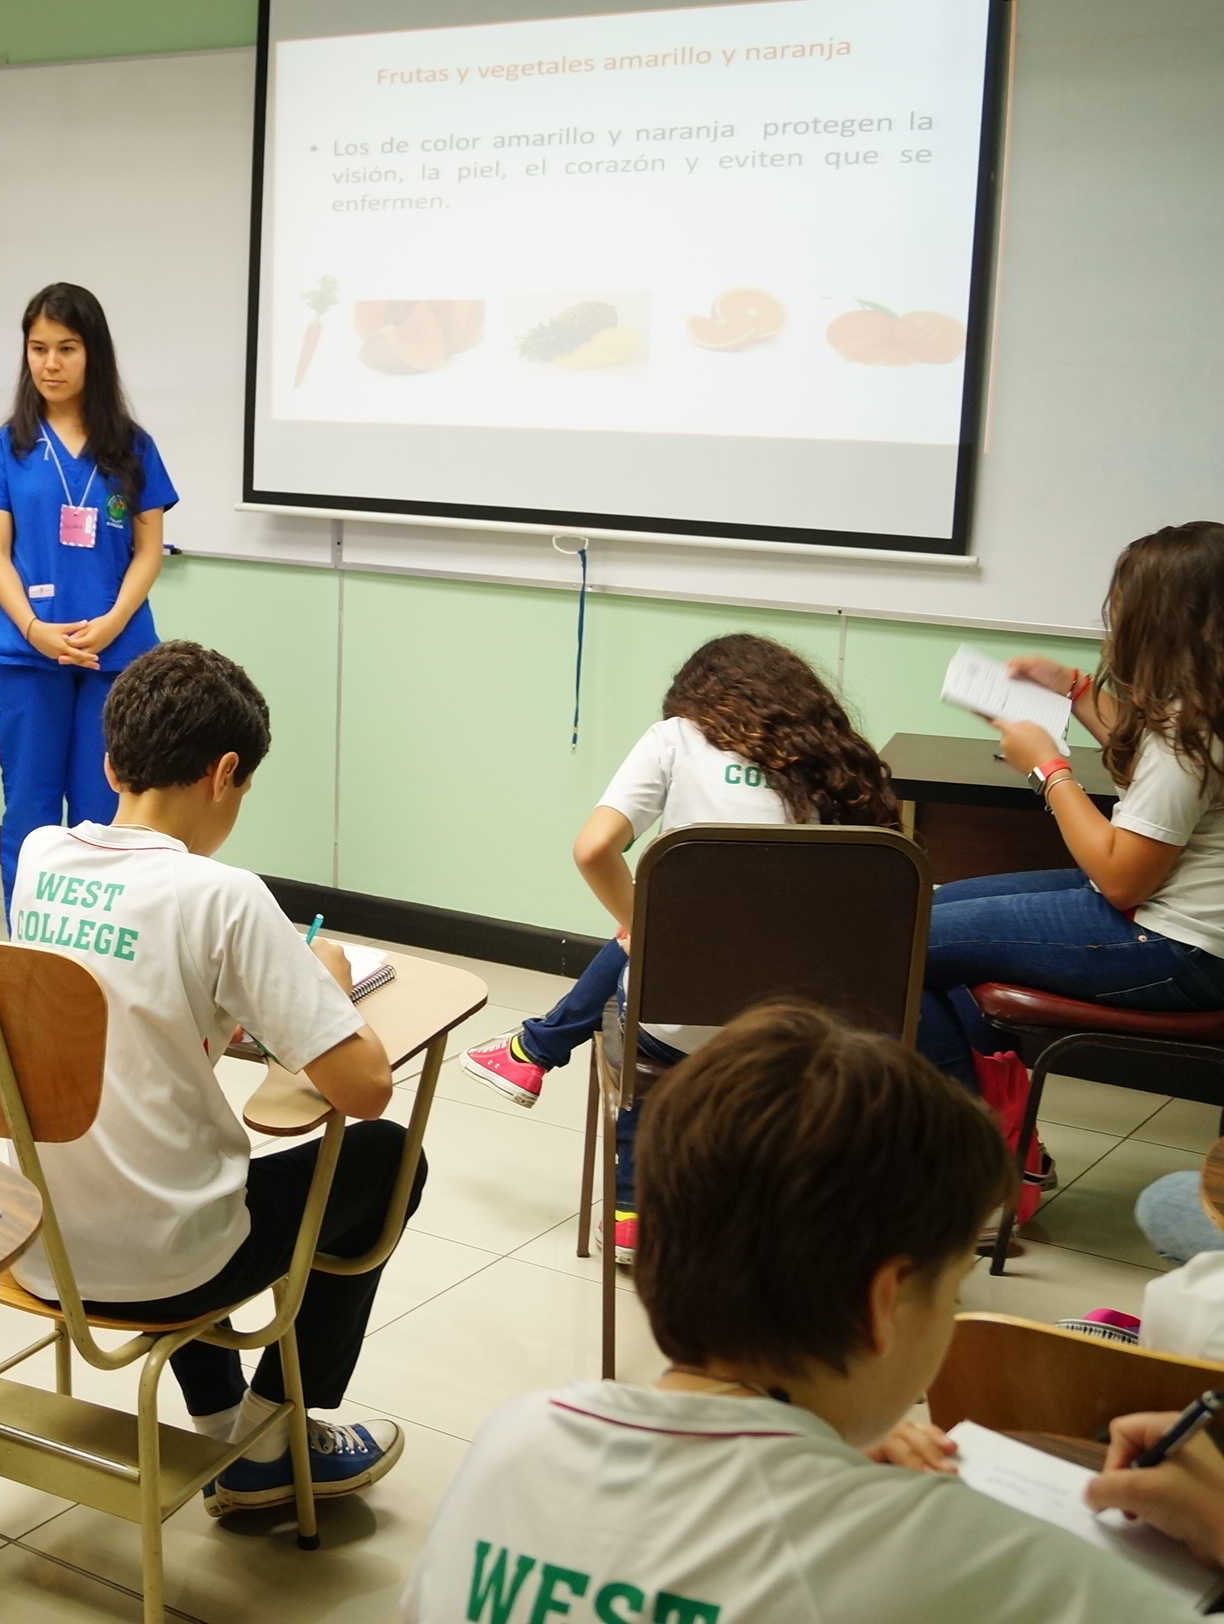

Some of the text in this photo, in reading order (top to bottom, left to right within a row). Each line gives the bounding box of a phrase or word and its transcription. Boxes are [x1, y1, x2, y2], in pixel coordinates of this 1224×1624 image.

[376, 38, 852, 85] Frutas y vegetales amarillo y naranja
[333, 110, 933, 156] Los de color amarillo y naranja protegen la
[332, 148, 932, 185] visión, la piel, el corazón y eviten que se
[331, 194, 450, 213] enfermen.
[725, 764, 773, 789] CO
[36, 871, 125, 912] WEST
[17, 910, 139, 961] COLLEGE
